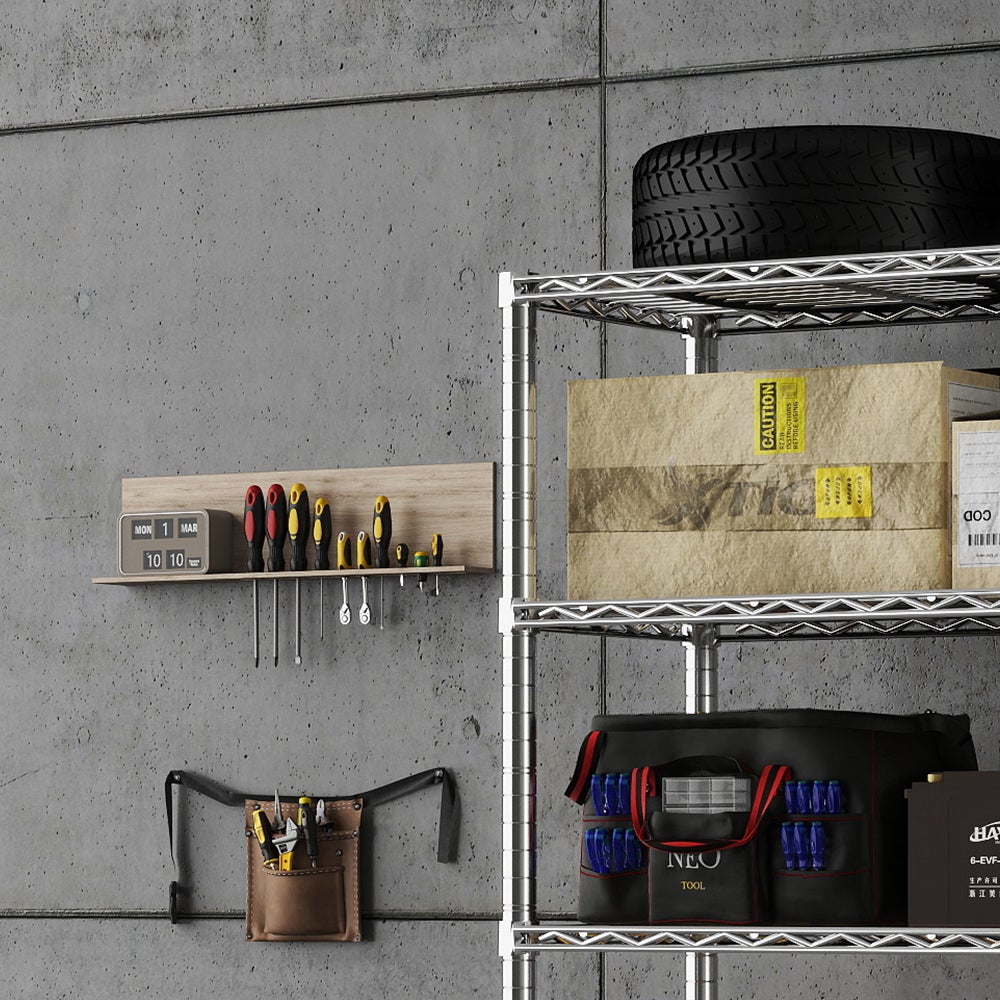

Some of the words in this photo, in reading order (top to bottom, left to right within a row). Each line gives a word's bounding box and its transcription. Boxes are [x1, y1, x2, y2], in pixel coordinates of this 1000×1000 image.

[762, 384, 775, 449] CAUTION
[964, 510, 992, 522] COD
[134, 525, 152, 534] MON
[162, 522, 168, 536] 1
[181, 523, 198, 533] MAR
[147, 554, 161, 567] 10
[170, 553, 184, 567] 10
[667, 851, 720, 868] NEO
[681, 881, 705, 890] TOOL
